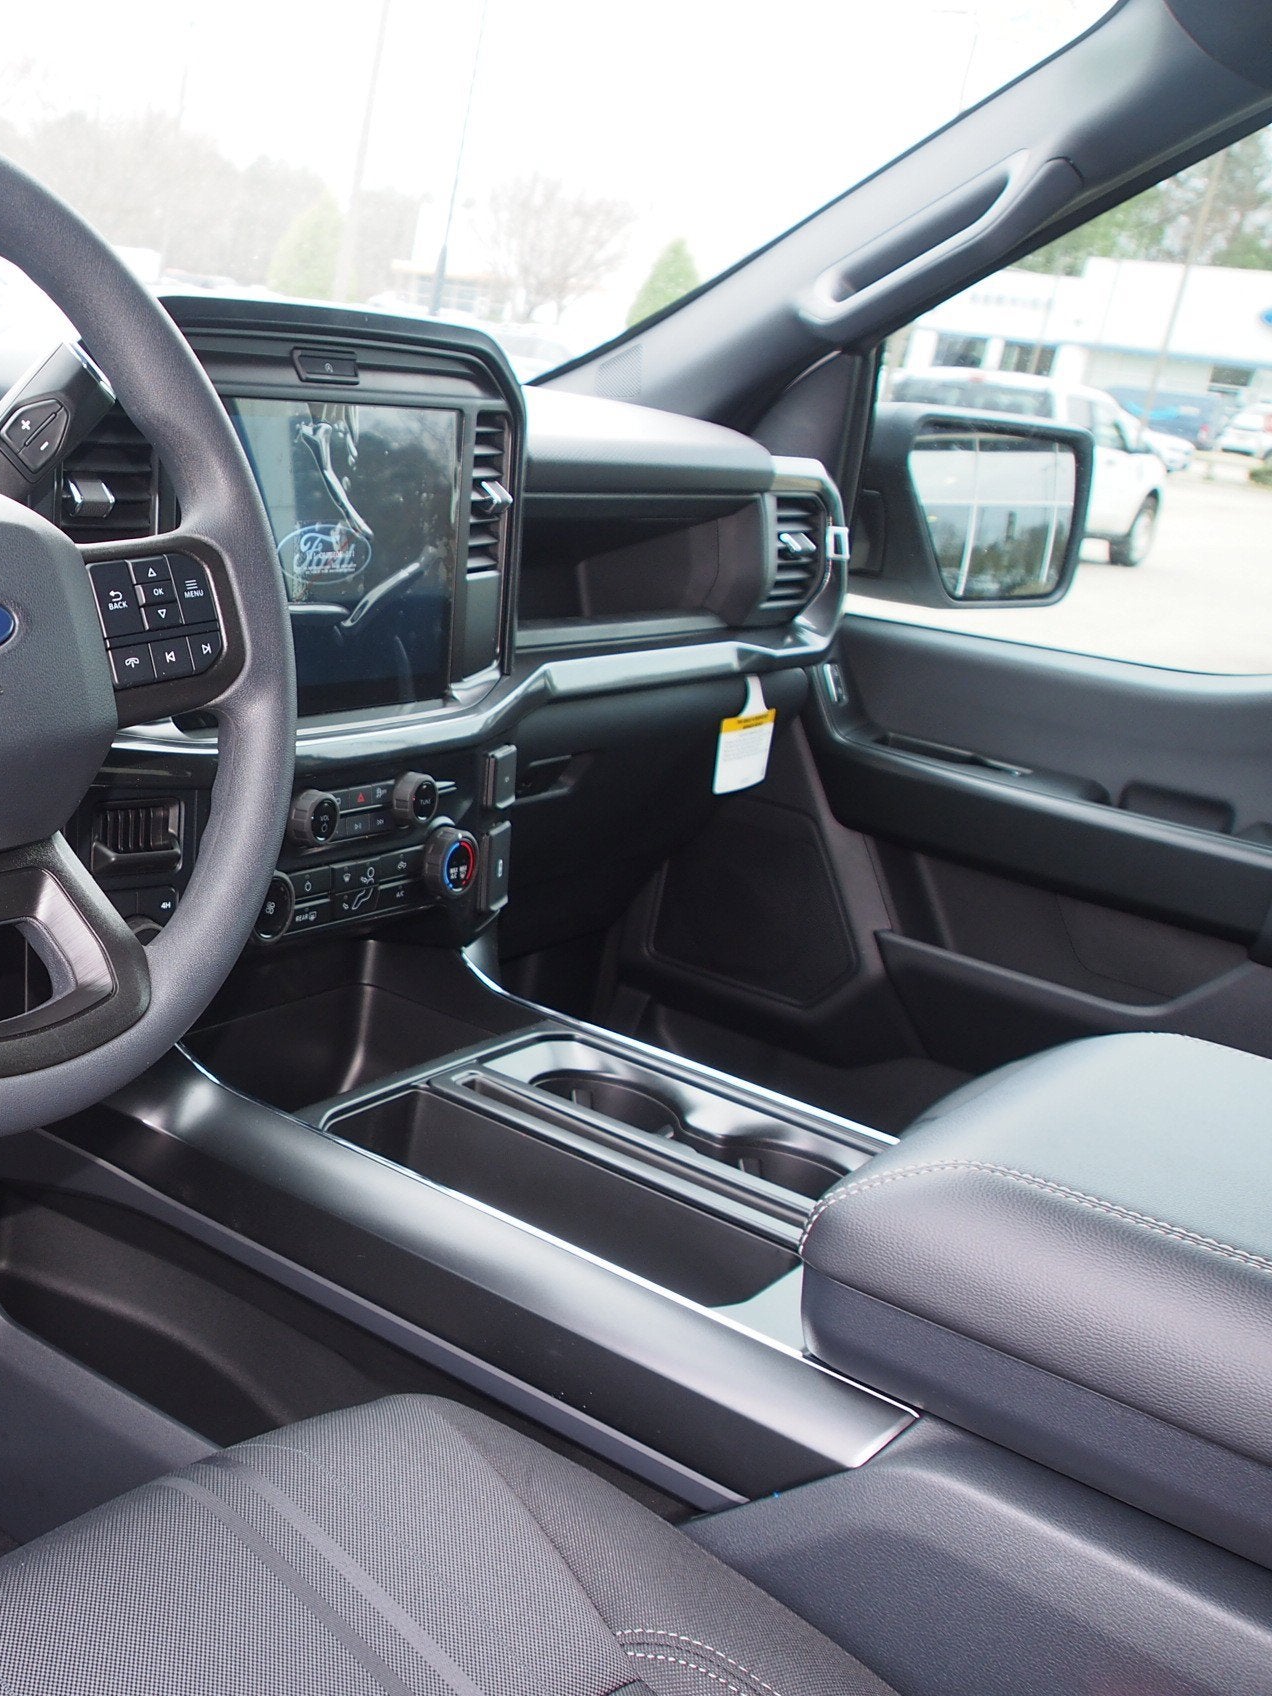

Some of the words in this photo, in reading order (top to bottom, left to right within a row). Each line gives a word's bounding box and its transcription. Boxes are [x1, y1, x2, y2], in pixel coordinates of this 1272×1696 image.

[293, 532, 356, 574] Ford
[153, 588, 164, 596] OK
[184, 589, 204, 599] MENU
[108, 601, 128, 611] BACK
[160, 901, 171, 909] 4H
[295, 914, 308, 922] REAR
